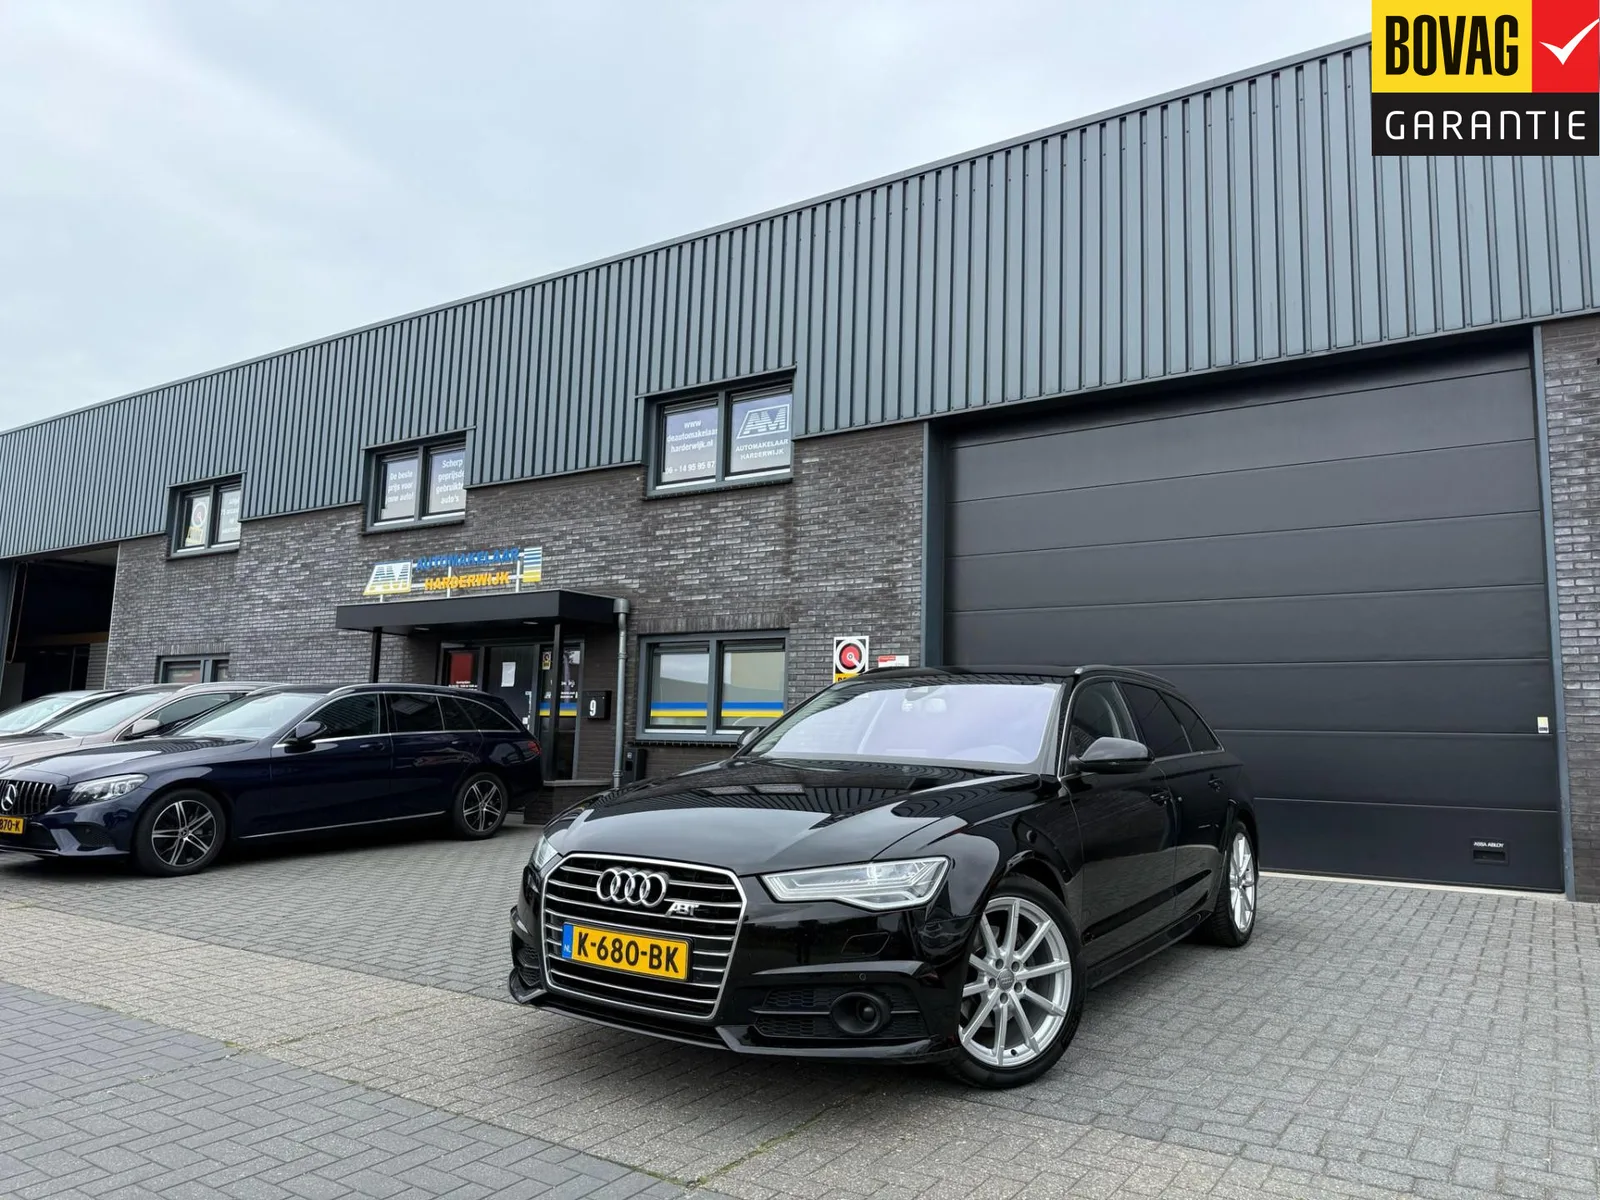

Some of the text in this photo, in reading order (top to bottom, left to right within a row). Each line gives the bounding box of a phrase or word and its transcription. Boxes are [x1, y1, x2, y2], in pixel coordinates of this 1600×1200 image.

[670, 439, 714, 453] harderwijk.nl
[735, 438, 789, 452] AUTOMAKELAAR
[740, 448, 784, 461] HARDERWIJK
[442, 459, 463, 468] Scherp
[415, 548, 520, 571] AUTOMAKELAAR
[424, 571, 511, 591] HARDERWIJK
[589, 699, 597, 717] 9
[665, 901, 700, 917] ABT
[563, 943, 572, 953] NL
[576, 931, 680, 974] K-680-BK
